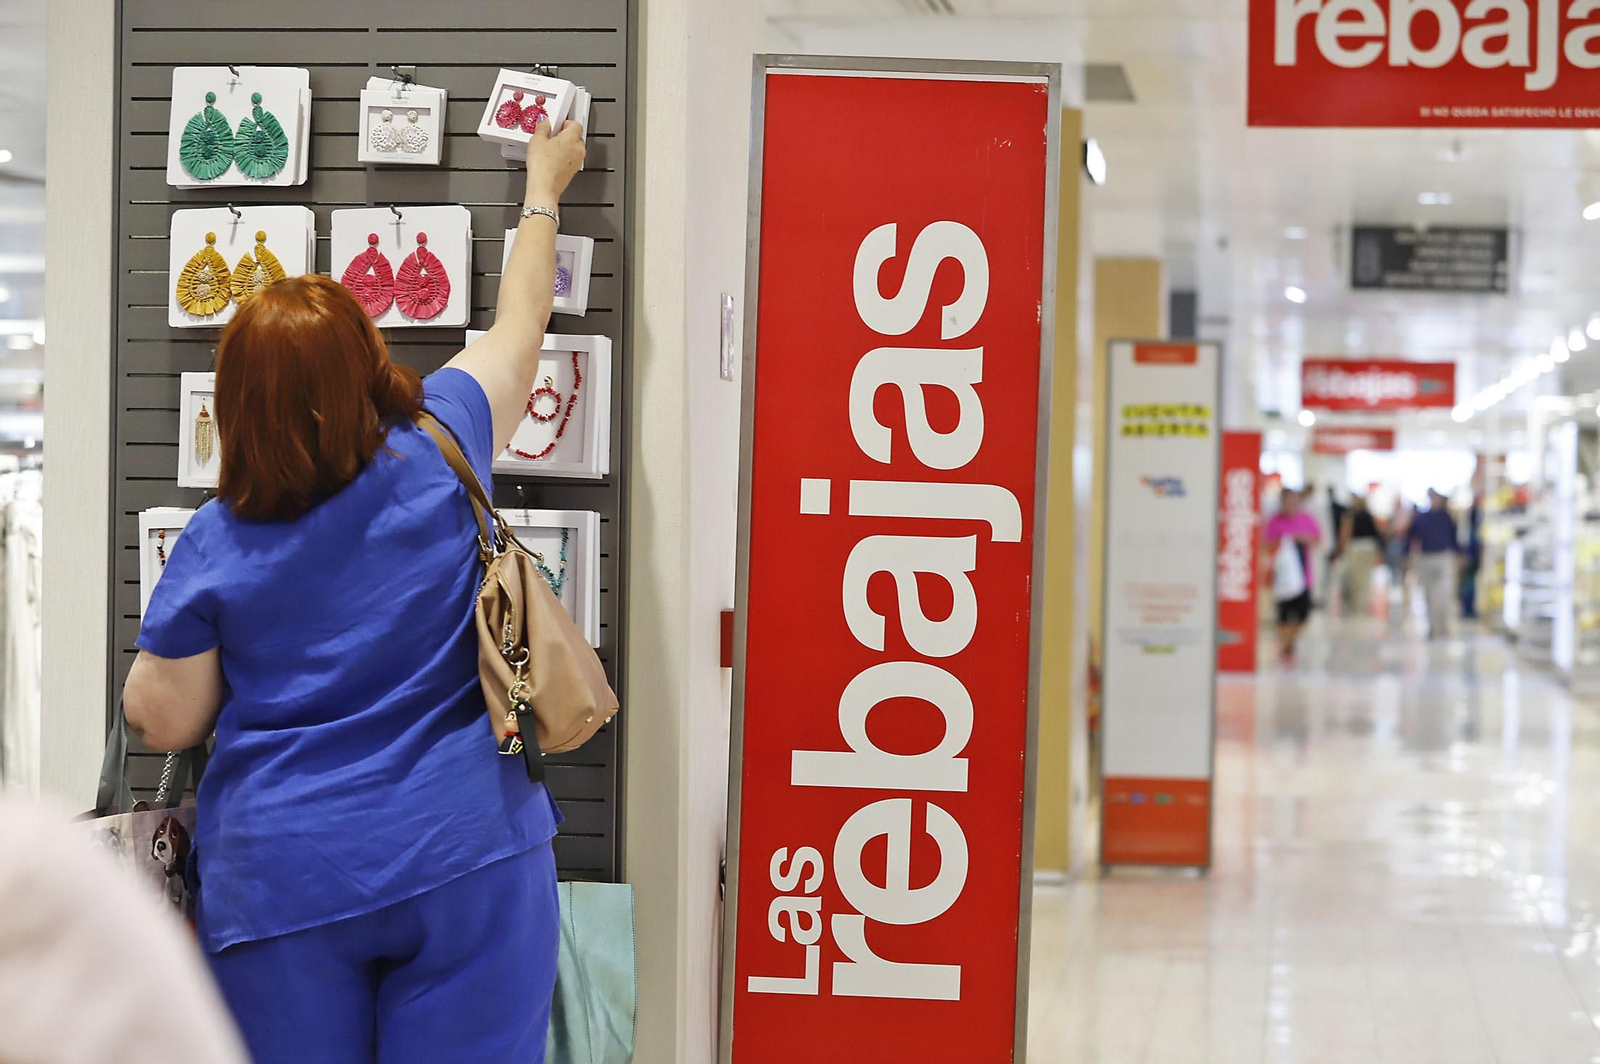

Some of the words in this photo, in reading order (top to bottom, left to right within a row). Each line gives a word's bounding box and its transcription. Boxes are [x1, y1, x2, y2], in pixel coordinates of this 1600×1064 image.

[1419, 106, 1431, 117] SI
[1433, 106, 1449, 117] NO
[1451, 106, 1488, 118] QUEDA
[1491, 106, 1557, 118] SATISFECHO
[1559, 107, 1573, 118] LE
[1120, 422, 1209, 439] ABIERTA
[791, 220, 1022, 1001] rebajas
[747, 846, 825, 996] Las
